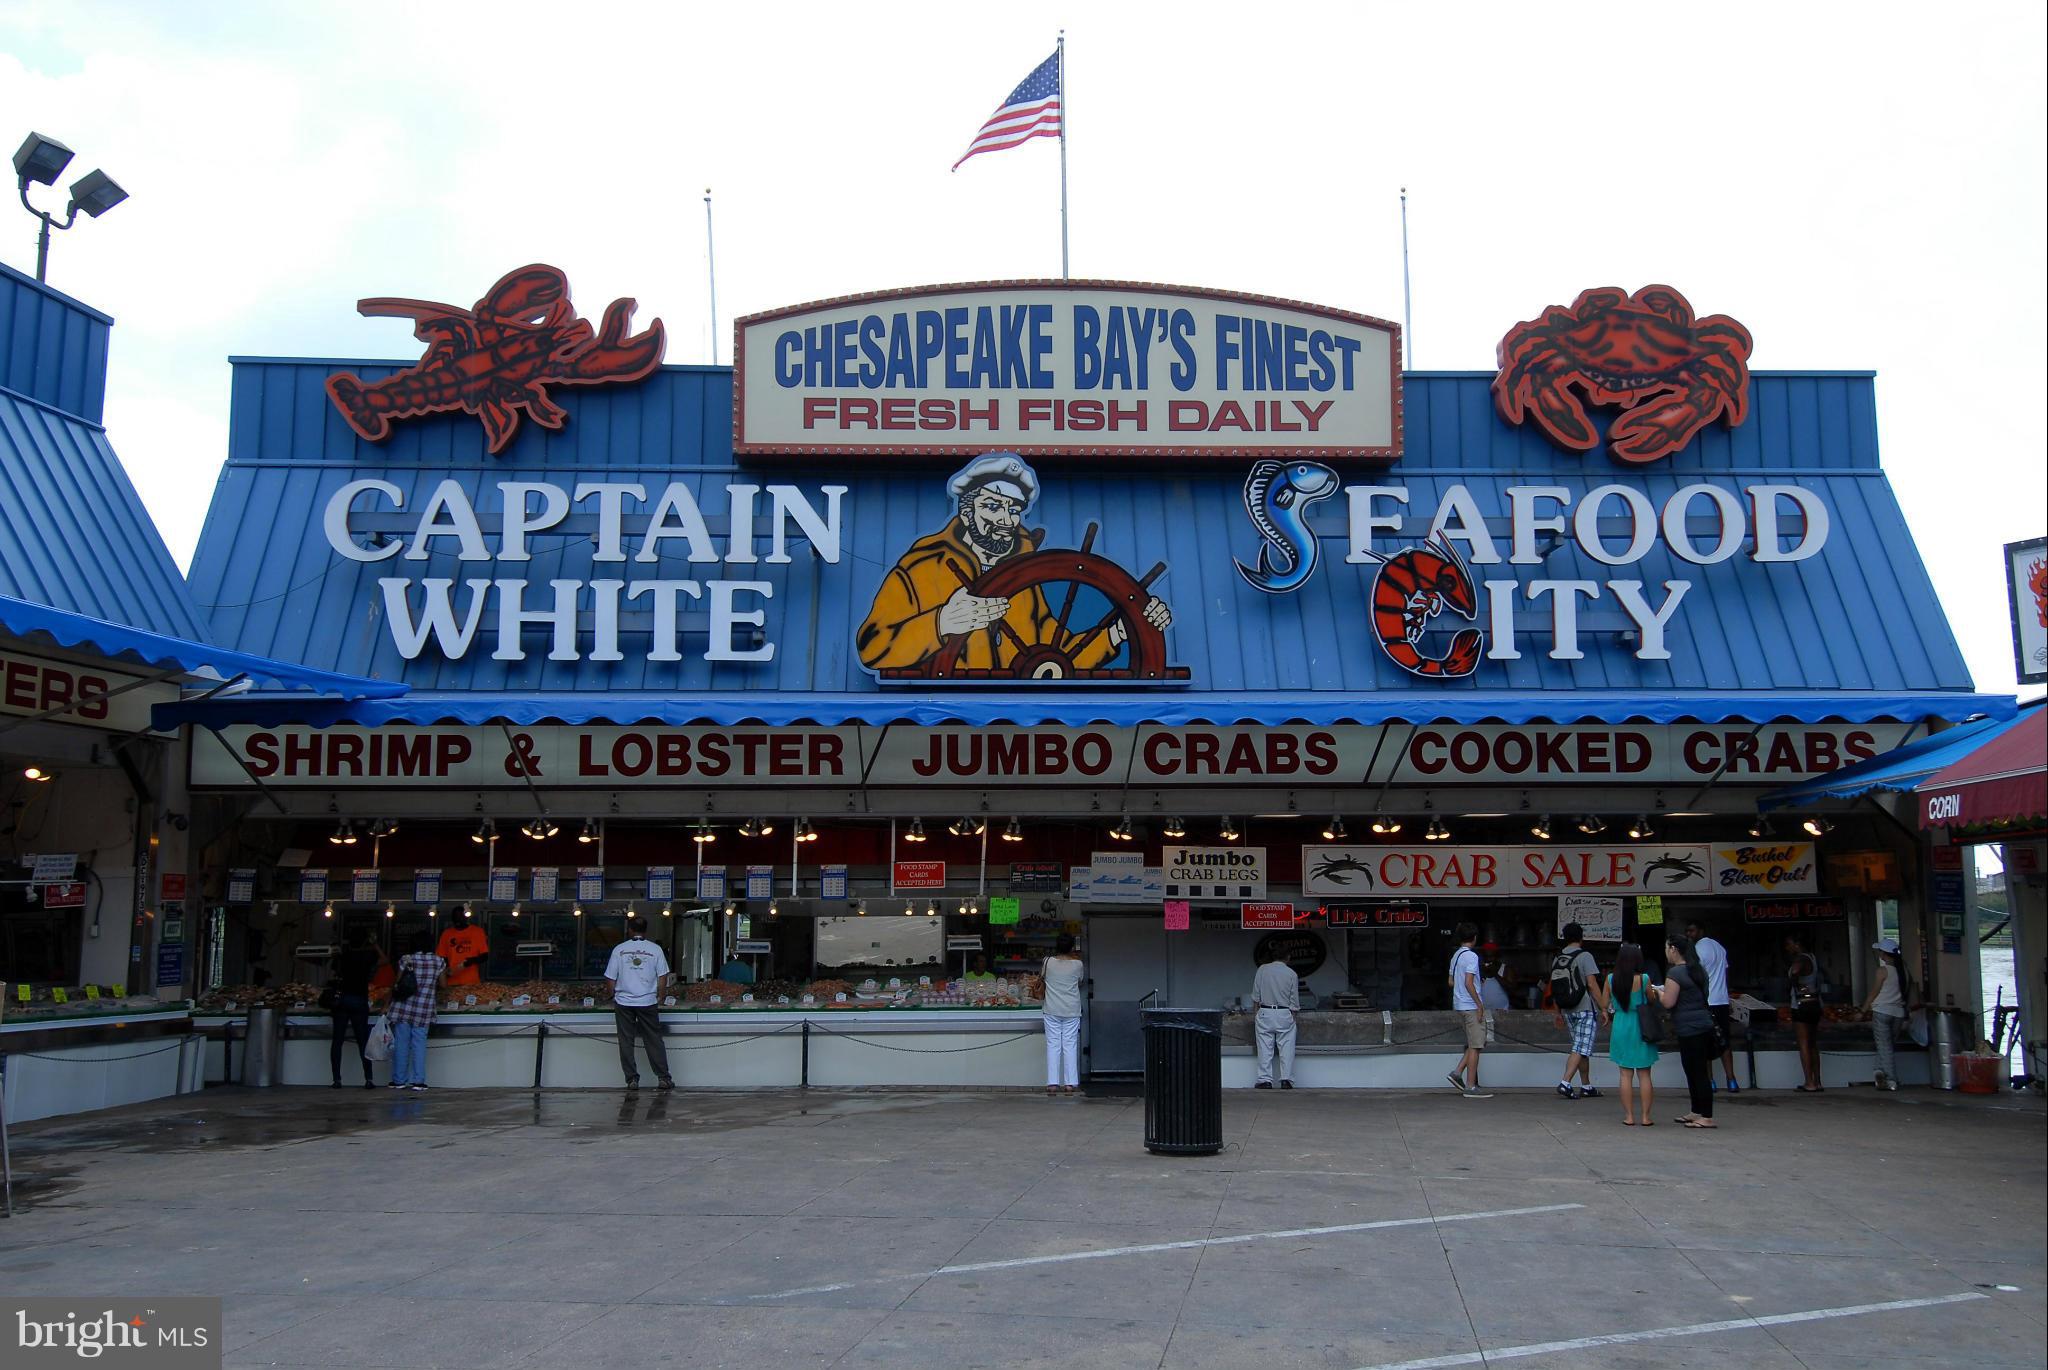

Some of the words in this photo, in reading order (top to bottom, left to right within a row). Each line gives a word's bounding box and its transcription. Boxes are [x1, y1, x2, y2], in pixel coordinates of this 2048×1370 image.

[774, 304, 1053, 390] CHESAPEAKE
[1074, 304, 1197, 391] BAY'S
[1215, 313, 1361, 392] FINEST
[802, 397, 1000, 431] FRESH
[1018, 398, 1148, 431] FISH
[1169, 400, 1335, 432] DAILY
[323, 479, 849, 565] CAPTAIN
[378, 577, 776, 662] WHITE
[244, 732, 472, 778] SHRIMP
[504, 732, 543, 777] &
[578, 733, 844, 777] LOBSTER
[912, 732, 1113, 777] JUMBO
[1143, 731, 1339, 776] CRABS
[1409, 731, 1652, 775] COOKED
[1683, 731, 1877, 775] CRABS
[1928, 794, 1960, 820] CORN
[1093, 856, 1117, 864] JUMBO
[1118, 856, 1143, 864] JUMBO
[1174, 850, 1255, 866] Jumbo
[1379, 853, 1498, 888] CRAB
[1522, 852, 1636, 888] SALE
[1735, 846, 1794, 865] Bushel
[1170, 868, 1214, 881] CRAB
[1219, 868, 1259, 881] LEGS
[1720, 867, 1764, 887] Blow
[1766, 864, 1811, 884] Out!
[1330, 908, 1368, 924] Live
[1375, 907, 1425, 924] Crabs
